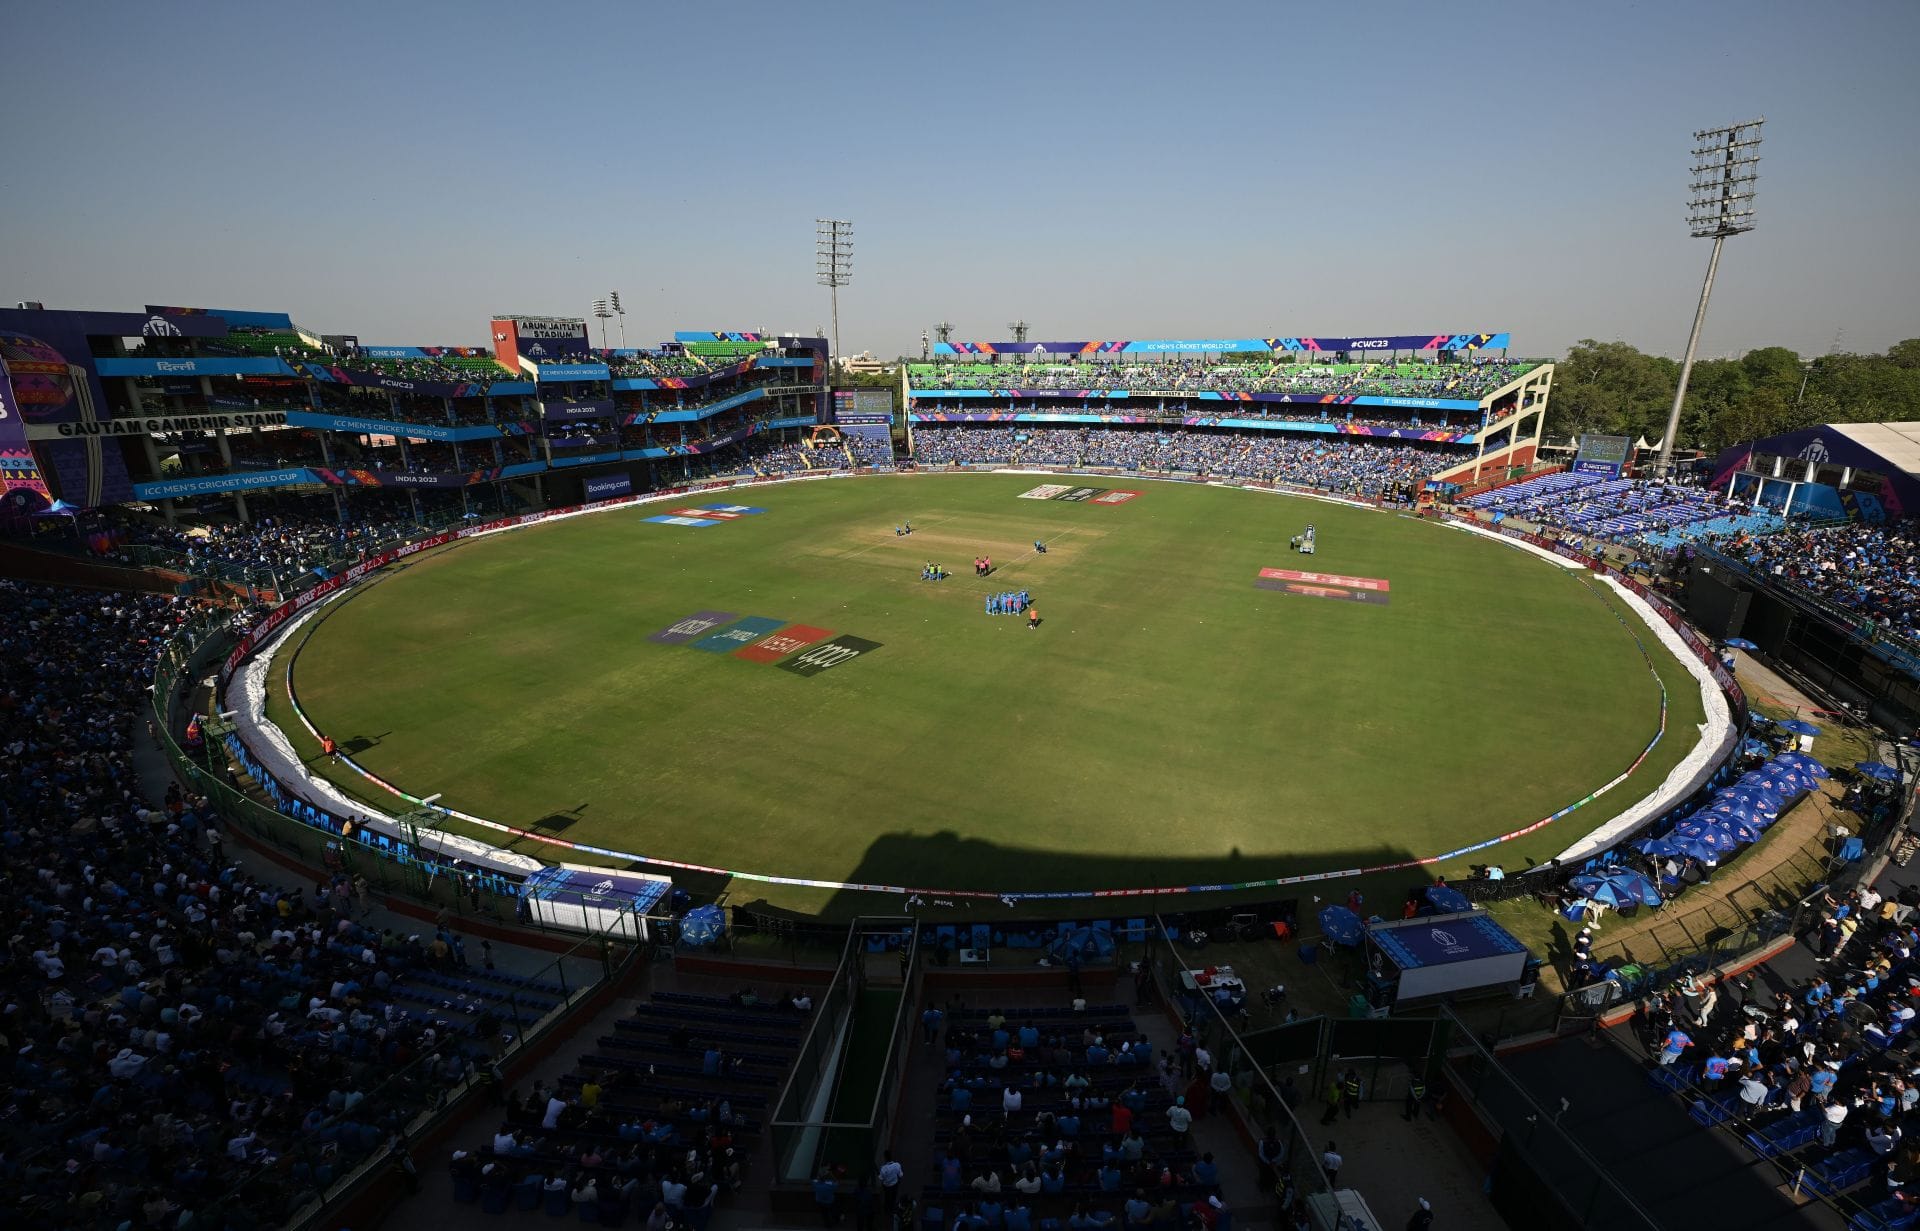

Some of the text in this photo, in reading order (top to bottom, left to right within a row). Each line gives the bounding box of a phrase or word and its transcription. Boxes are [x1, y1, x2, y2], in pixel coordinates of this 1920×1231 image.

[522, 322, 581, 331] ARUN JAITLEY
[1351, 340, 1388, 348] #CWC23
[380, 379, 413, 389] #CWC23
[57, 412, 287, 437] GAUTAM GAMBHIR STAND
[334, 419, 448, 438] ICC MEN'S CRICKET WORLD CUP
[144, 473, 298, 496] ICC MEN'S CRICKET WORLD CUP
[395, 475, 438, 484] INDIA 2023
[588, 480, 631, 494] Booking.com
[520, 512, 547, 523] MRF
[456, 525, 481, 539] MRF
[397, 535, 444, 557] MRF ZLX
[346, 564, 368, 581] MRF
[295, 590, 317, 609] MRF
[253, 620, 272, 641] MRF
